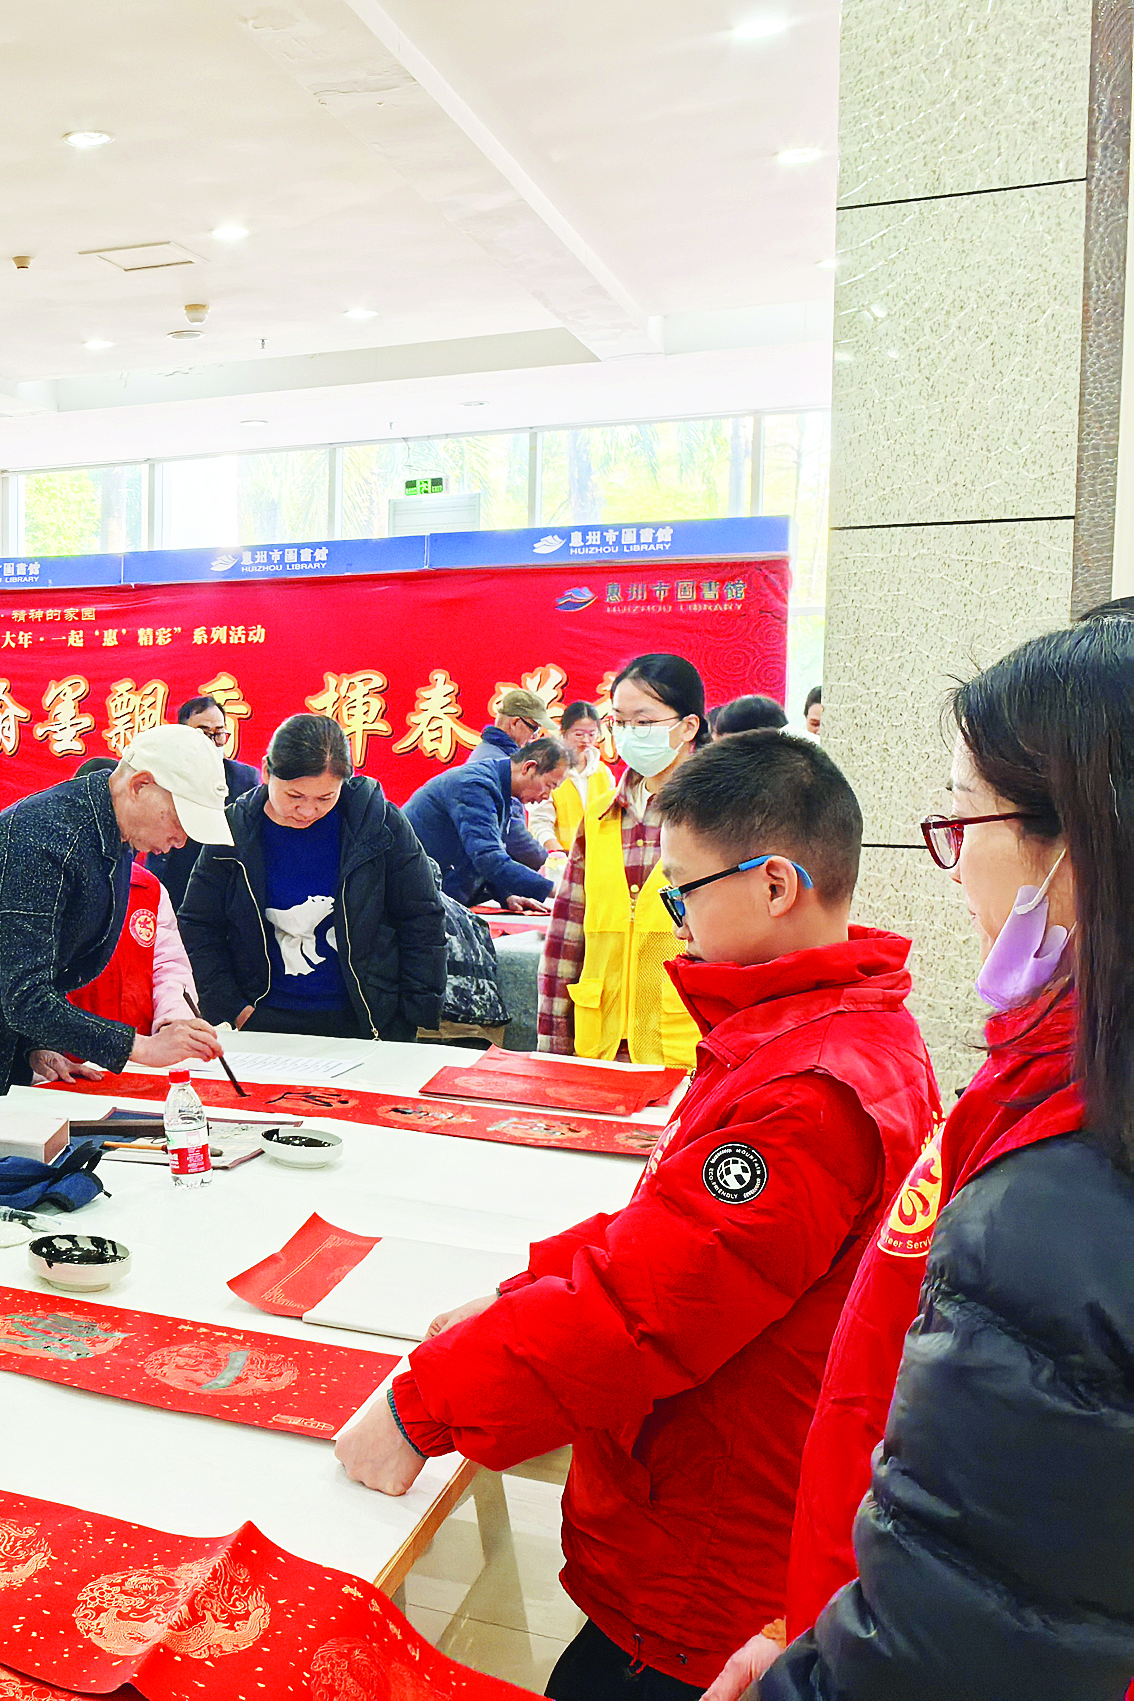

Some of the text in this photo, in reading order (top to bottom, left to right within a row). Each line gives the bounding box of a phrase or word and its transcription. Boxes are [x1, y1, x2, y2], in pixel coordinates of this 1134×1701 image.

[569, 543, 672, 555] HUIZHOU LIBRARY
[241, 562, 327, 572] HUIZHOU LIBRARY
[5, 575, 40, 584] LIBRARY
[606, 604, 672, 613] HUIZHOU
